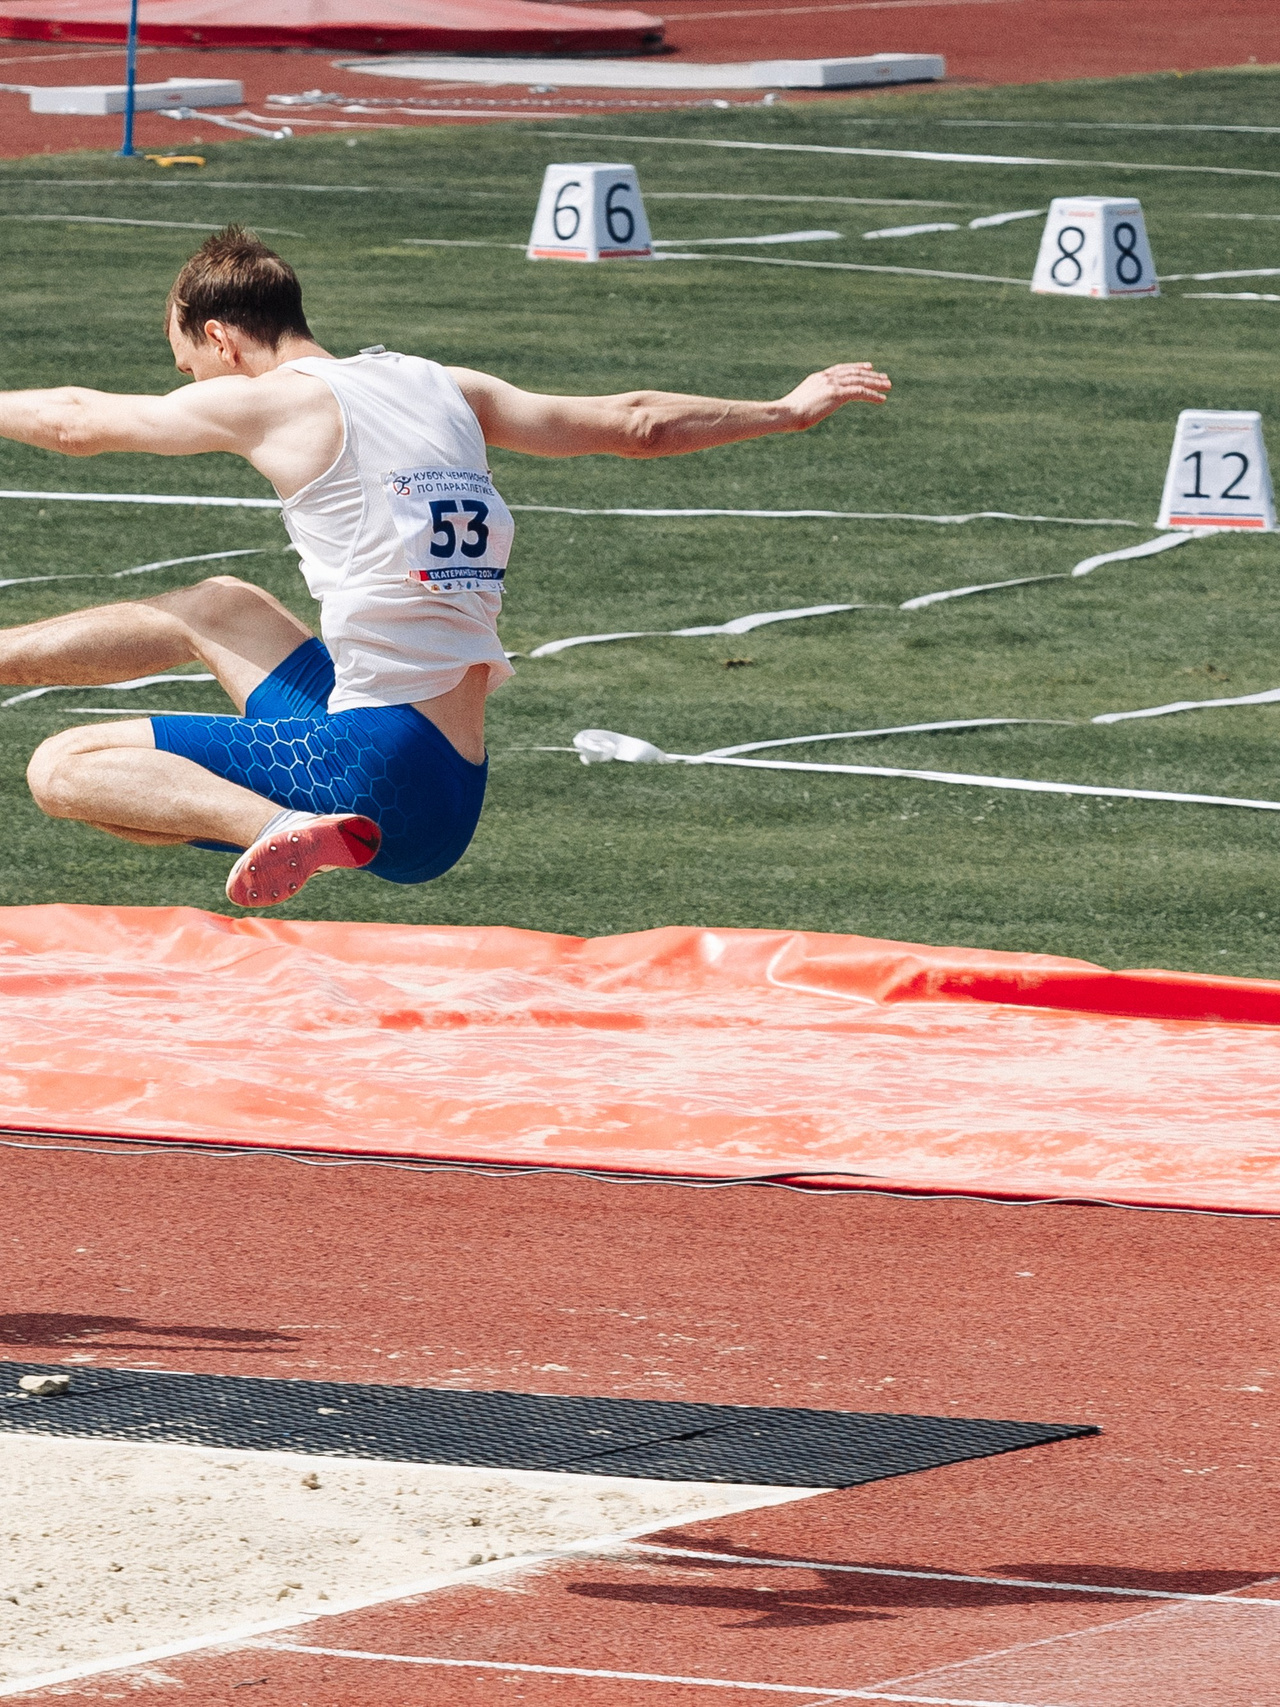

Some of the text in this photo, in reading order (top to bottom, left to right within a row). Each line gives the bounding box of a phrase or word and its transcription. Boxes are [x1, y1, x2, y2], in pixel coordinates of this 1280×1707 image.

[553, 181, 581, 241] 6
[605, 182, 635, 243] 6
[1051, 226, 1085, 287] 8
[1113, 221, 1143, 285] 8
[413, 471, 445, 481] КУБОК
[417, 483, 434, 494] ПО
[1183, 450, 1251, 500] 12
[429, 499, 489, 559] 53
